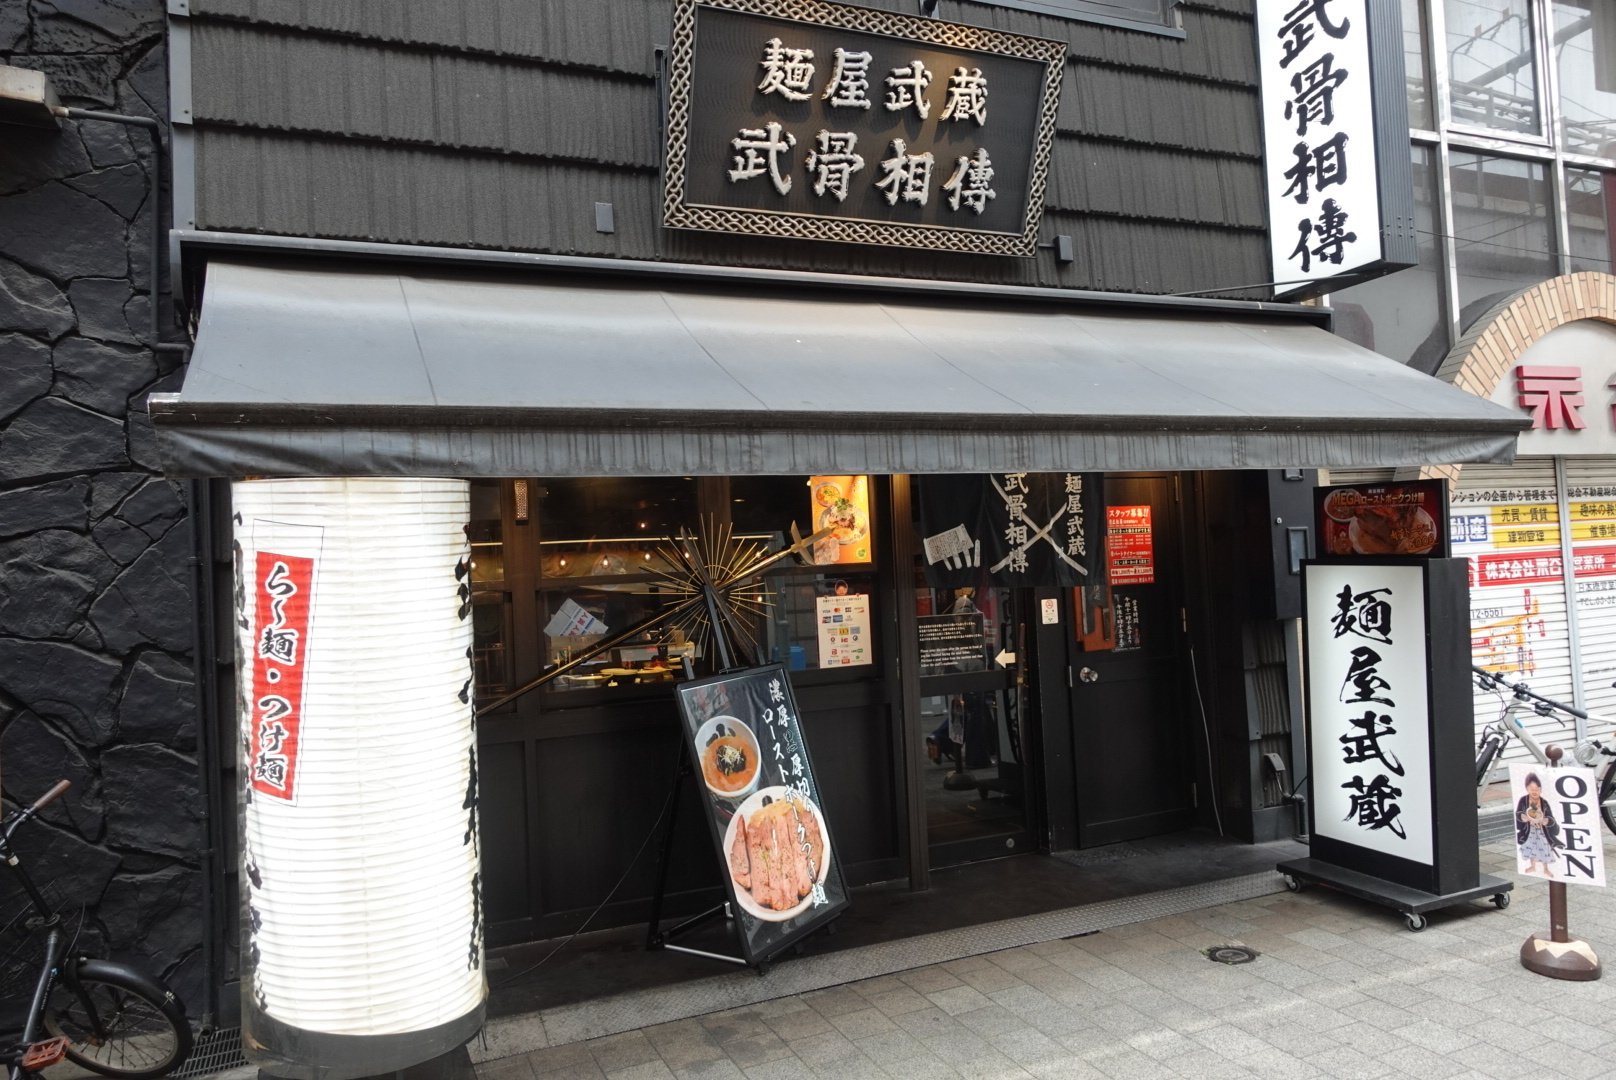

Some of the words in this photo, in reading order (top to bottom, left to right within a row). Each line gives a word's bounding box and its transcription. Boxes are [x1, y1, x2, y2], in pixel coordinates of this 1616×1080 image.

[758, 37, 988, 126] 麺屋武蔵
[728, 121, 997, 215] 武骨相傳
[1065, 473, 1086, 557] 麺屋武蔵
[1580, 504, 1616, 517] 趣味の教
[1330, 583, 1407, 840] 麺屋武蔵
[1555, 775, 1597, 879] OPEN
